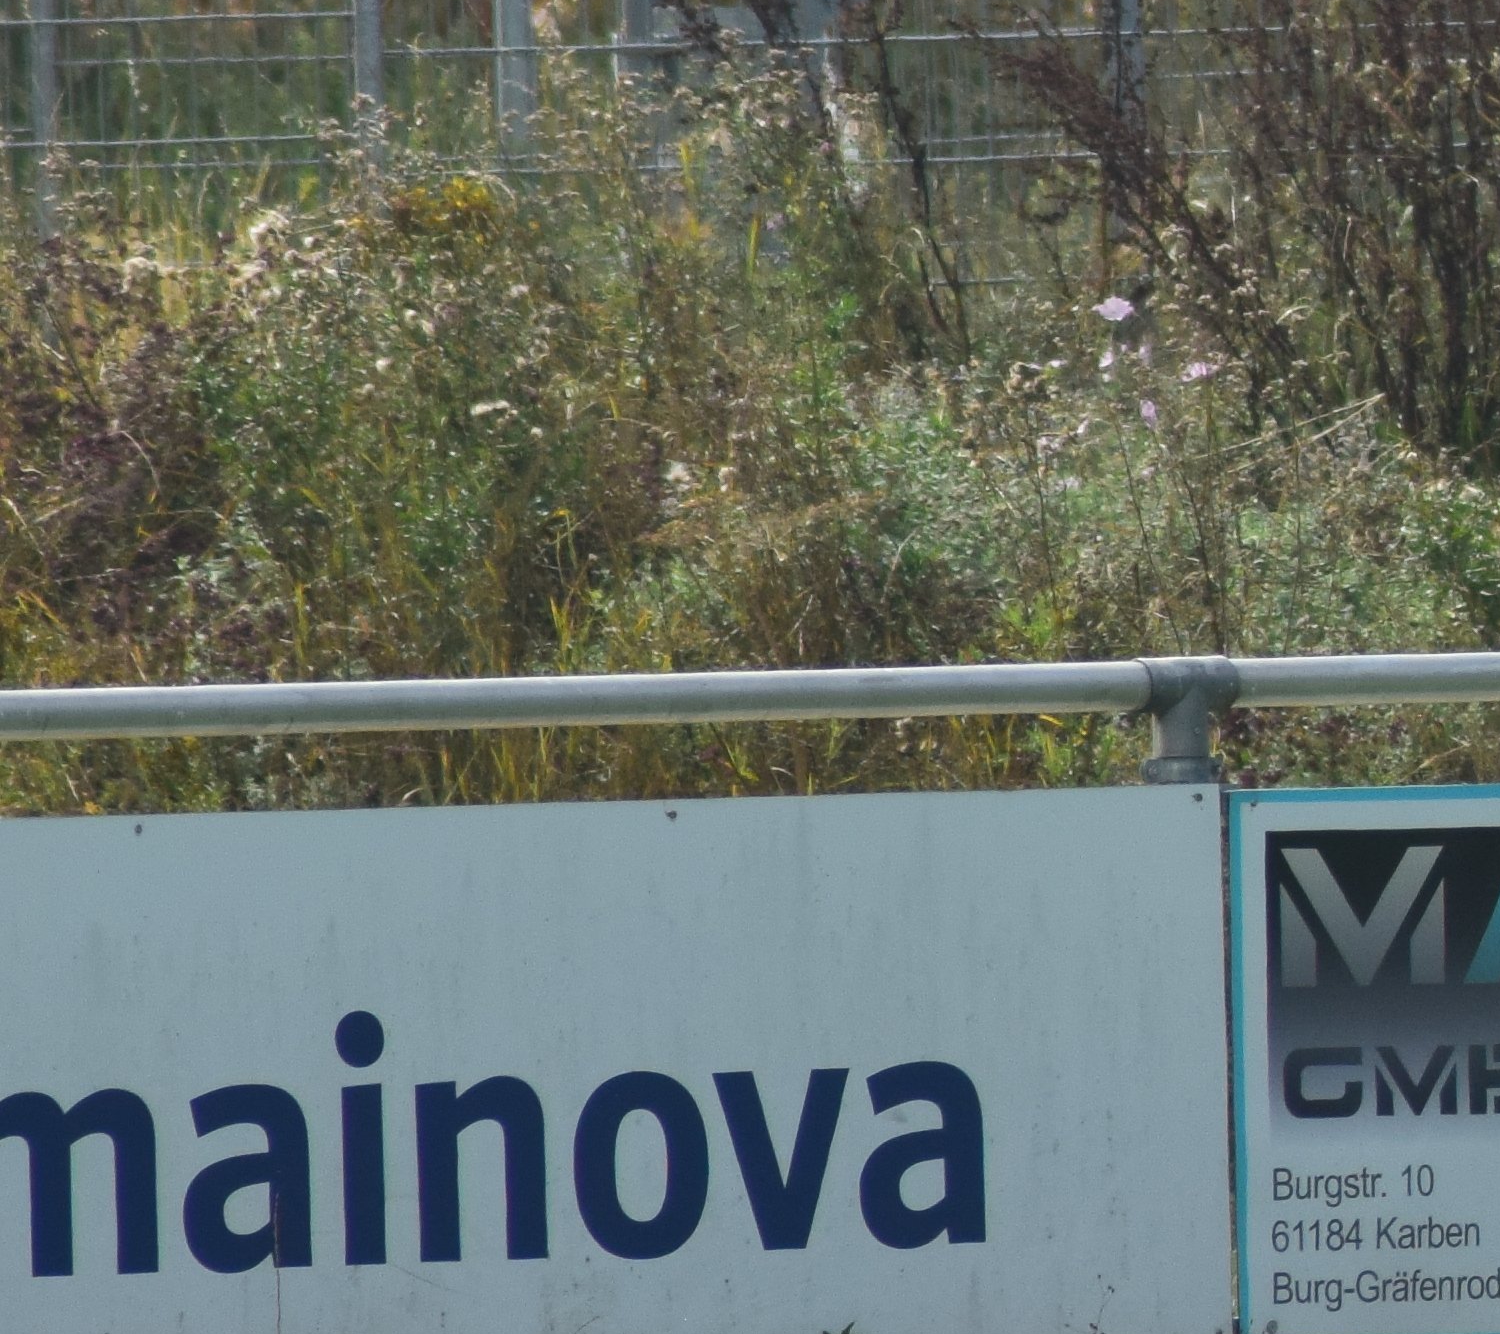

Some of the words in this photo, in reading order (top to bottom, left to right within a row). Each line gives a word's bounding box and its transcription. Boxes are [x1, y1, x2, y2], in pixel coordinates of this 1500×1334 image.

[0, 1010, 987, 1278] mainova
[1272, 1166, 1388, 1208] Burgstr.
[1400, 1163, 1435, 1198] 10
[1271, 1217, 1363, 1253] 61184
[1375, 1216, 1481, 1250] Karben
